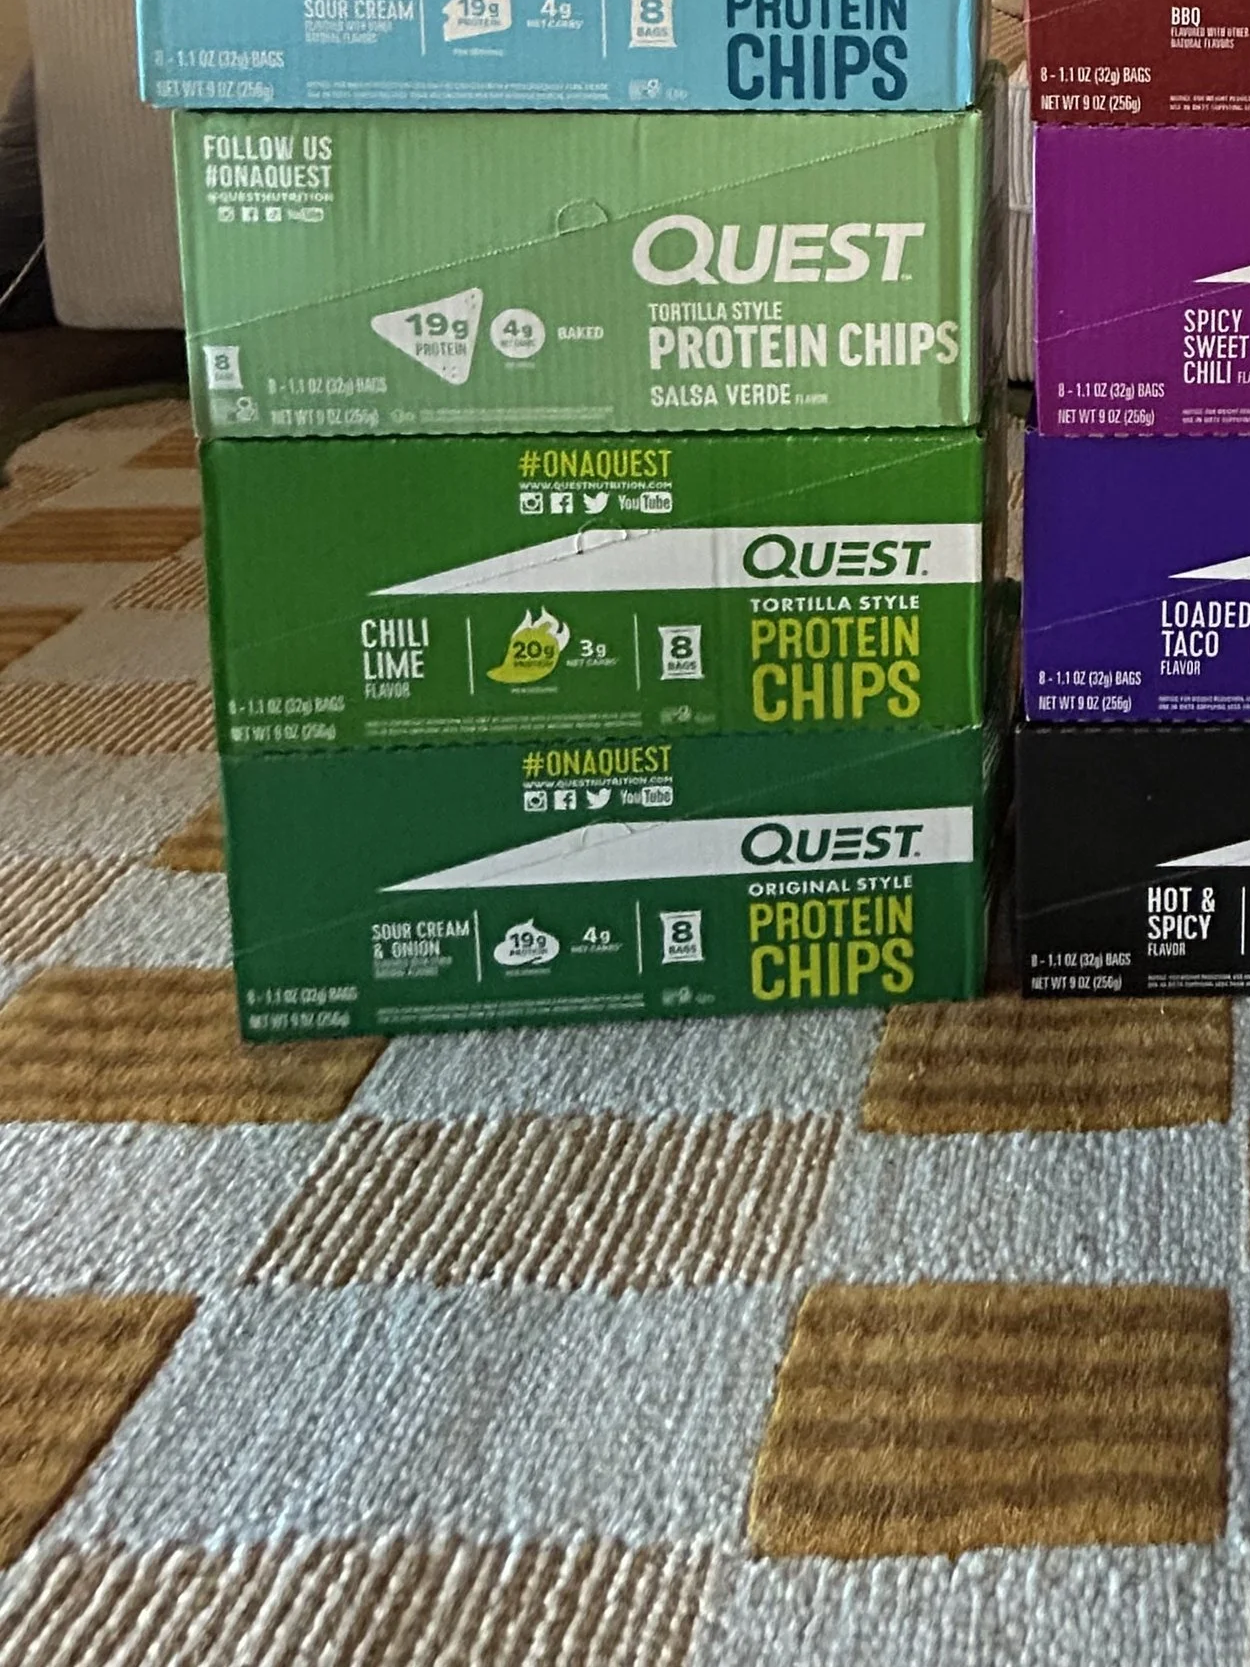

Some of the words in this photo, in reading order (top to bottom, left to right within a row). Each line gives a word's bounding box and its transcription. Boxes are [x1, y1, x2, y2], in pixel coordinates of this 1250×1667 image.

[304, 0, 348, 20] SOUR
[354, 0, 414, 21] CREAM
[1171, 7, 1200, 26] BBQ
[728, 34, 908, 101] CHIPS
[1041, 95, 1060, 110] NET
[1063, 95, 1080, 110] WT
[1083, 96, 1088, 110] 9
[1093, 96, 1105, 110] OZ
[1109, 95, 1141, 113] (256g)
[204, 136, 297, 160] FOLLOW
[302, 136, 333, 159] US
[205, 164, 331, 189] #ONAQUEST
[632, 215, 925, 284] QUEST
[649, 302, 727, 322] TORTILLA
[732, 302, 781, 321] STYLE
[1183, 308, 1243, 333] SPICY
[649, 322, 828, 370] PROTEIN
[838, 322, 959, 367] CHIPS
[1183, 336, 1249, 360] SWEET
[1183, 361, 1231, 386] CHILI
[651, 385, 720, 407] SALSA
[726, 384, 790, 407] VERDE
[518, 449, 673, 478] #ONAQUEST
[743, 533, 931, 578] QUEST
[751, 597, 851, 613] TORTILLA
[859, 595, 920, 610] STYLE
[361, 618, 430, 648] CHILI
[751, 616, 920, 659] PROTEIN
[1162, 631, 1219, 657] TACO
[670, 635, 694, 658] 8
[364, 651, 425, 680] LIME
[752, 663, 920, 722] CHIPS
[523, 746, 672, 776] #ONAQUEST
[741, 823, 923, 865] QUEST
[748, 877, 852, 897] ORIGINAL
[857, 875, 913, 891] STYLE
[1149, 888, 1194, 911] HOT
[1202, 888, 1216, 911] &
[750, 896, 913, 941] PROTEIN
[1147, 916, 1211, 940] SPICY
[672, 921, 693, 944] 8
[751, 941, 914, 1000] CHIPS
